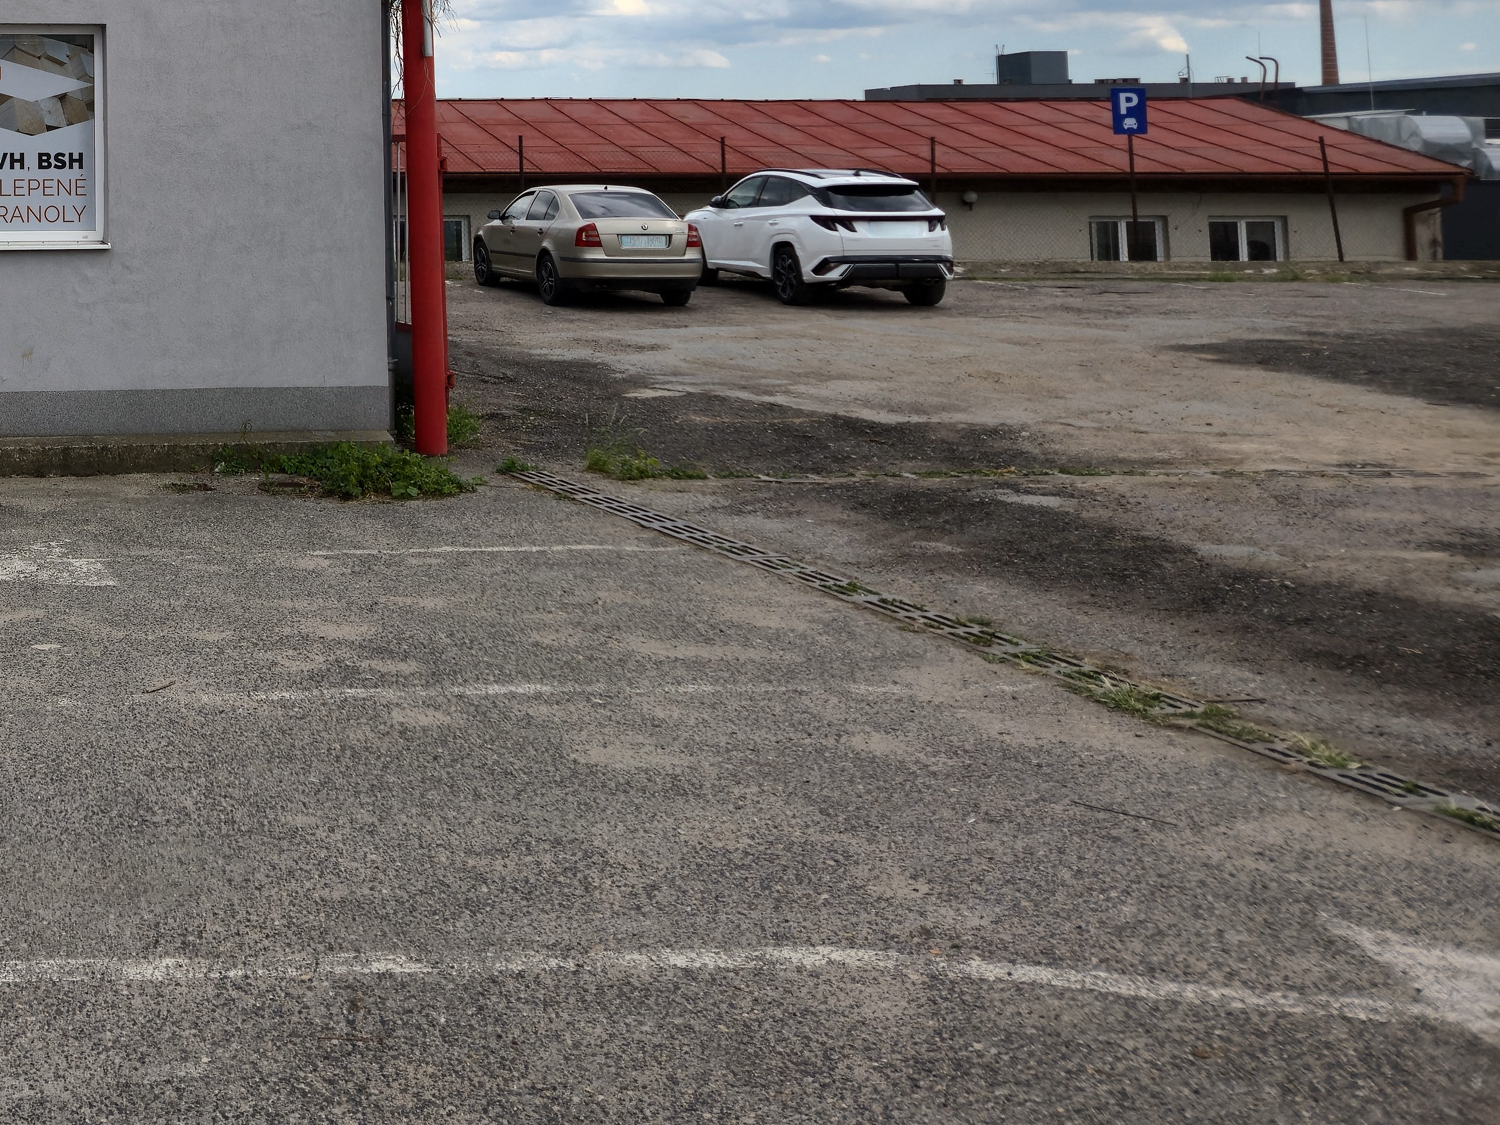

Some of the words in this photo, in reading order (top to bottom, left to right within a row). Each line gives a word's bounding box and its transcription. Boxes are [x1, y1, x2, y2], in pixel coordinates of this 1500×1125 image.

[1119, 92, 1138, 114] P
[37, 152, 84, 170] BSH
[0, 175, 86, 197] LEPENÉ
